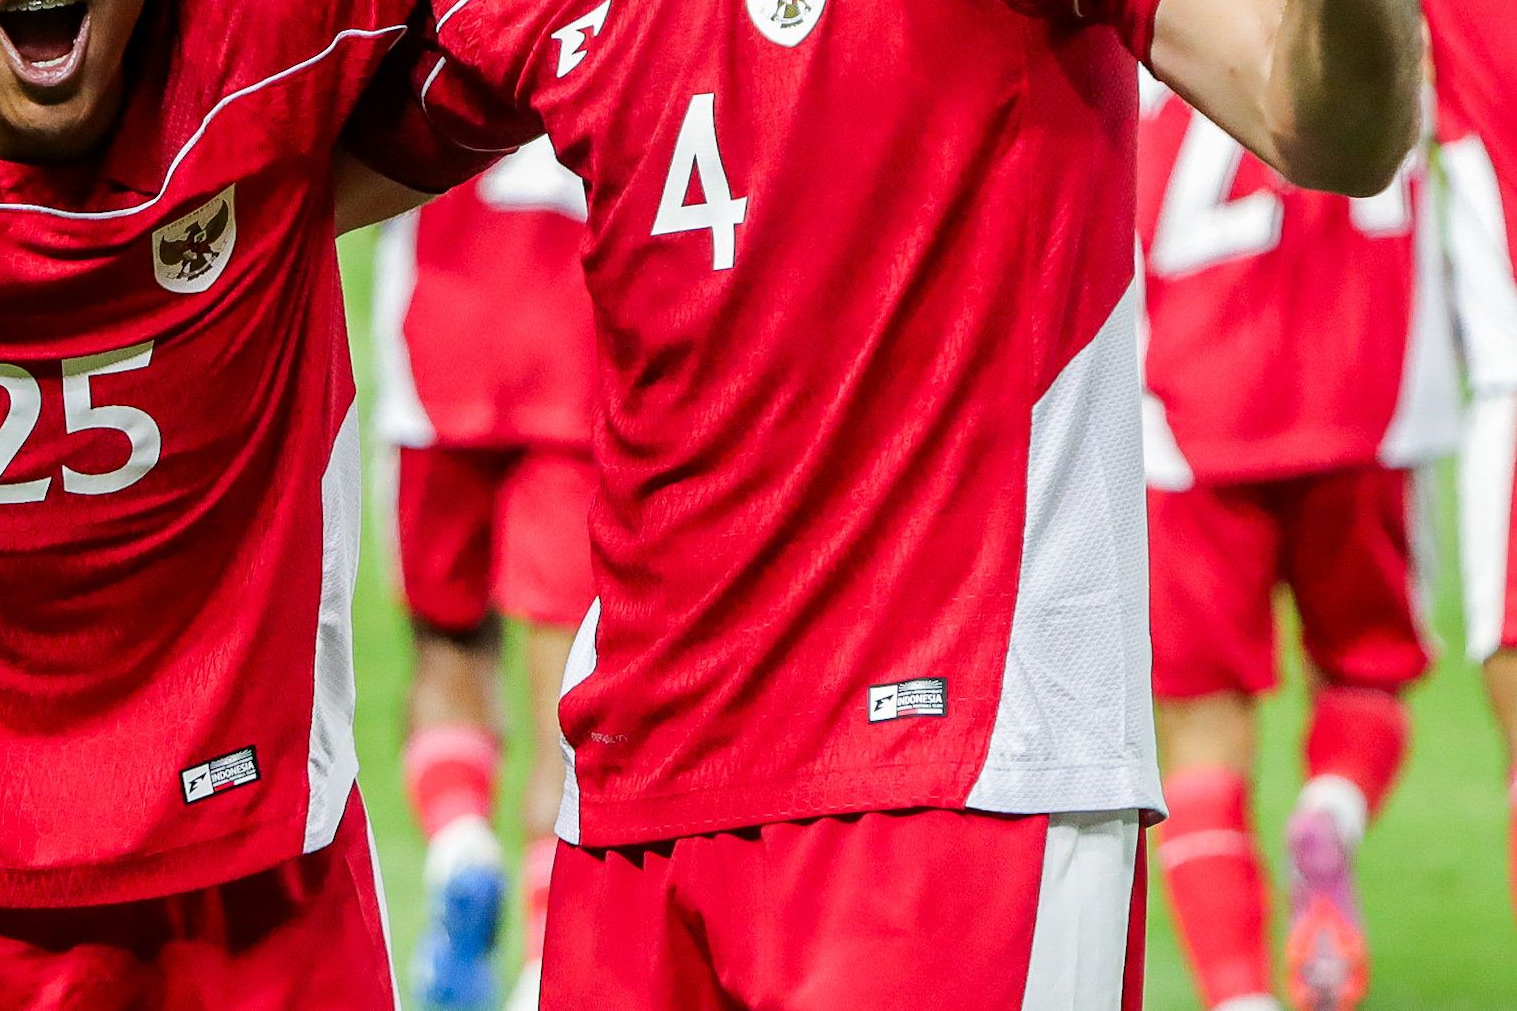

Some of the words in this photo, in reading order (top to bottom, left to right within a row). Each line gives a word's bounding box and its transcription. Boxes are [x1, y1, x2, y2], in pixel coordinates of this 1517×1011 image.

[650, 92, 748, 271] 4
[897, 692, 943, 707] INDONESIA
[210, 760, 256, 783] INDONESIA
